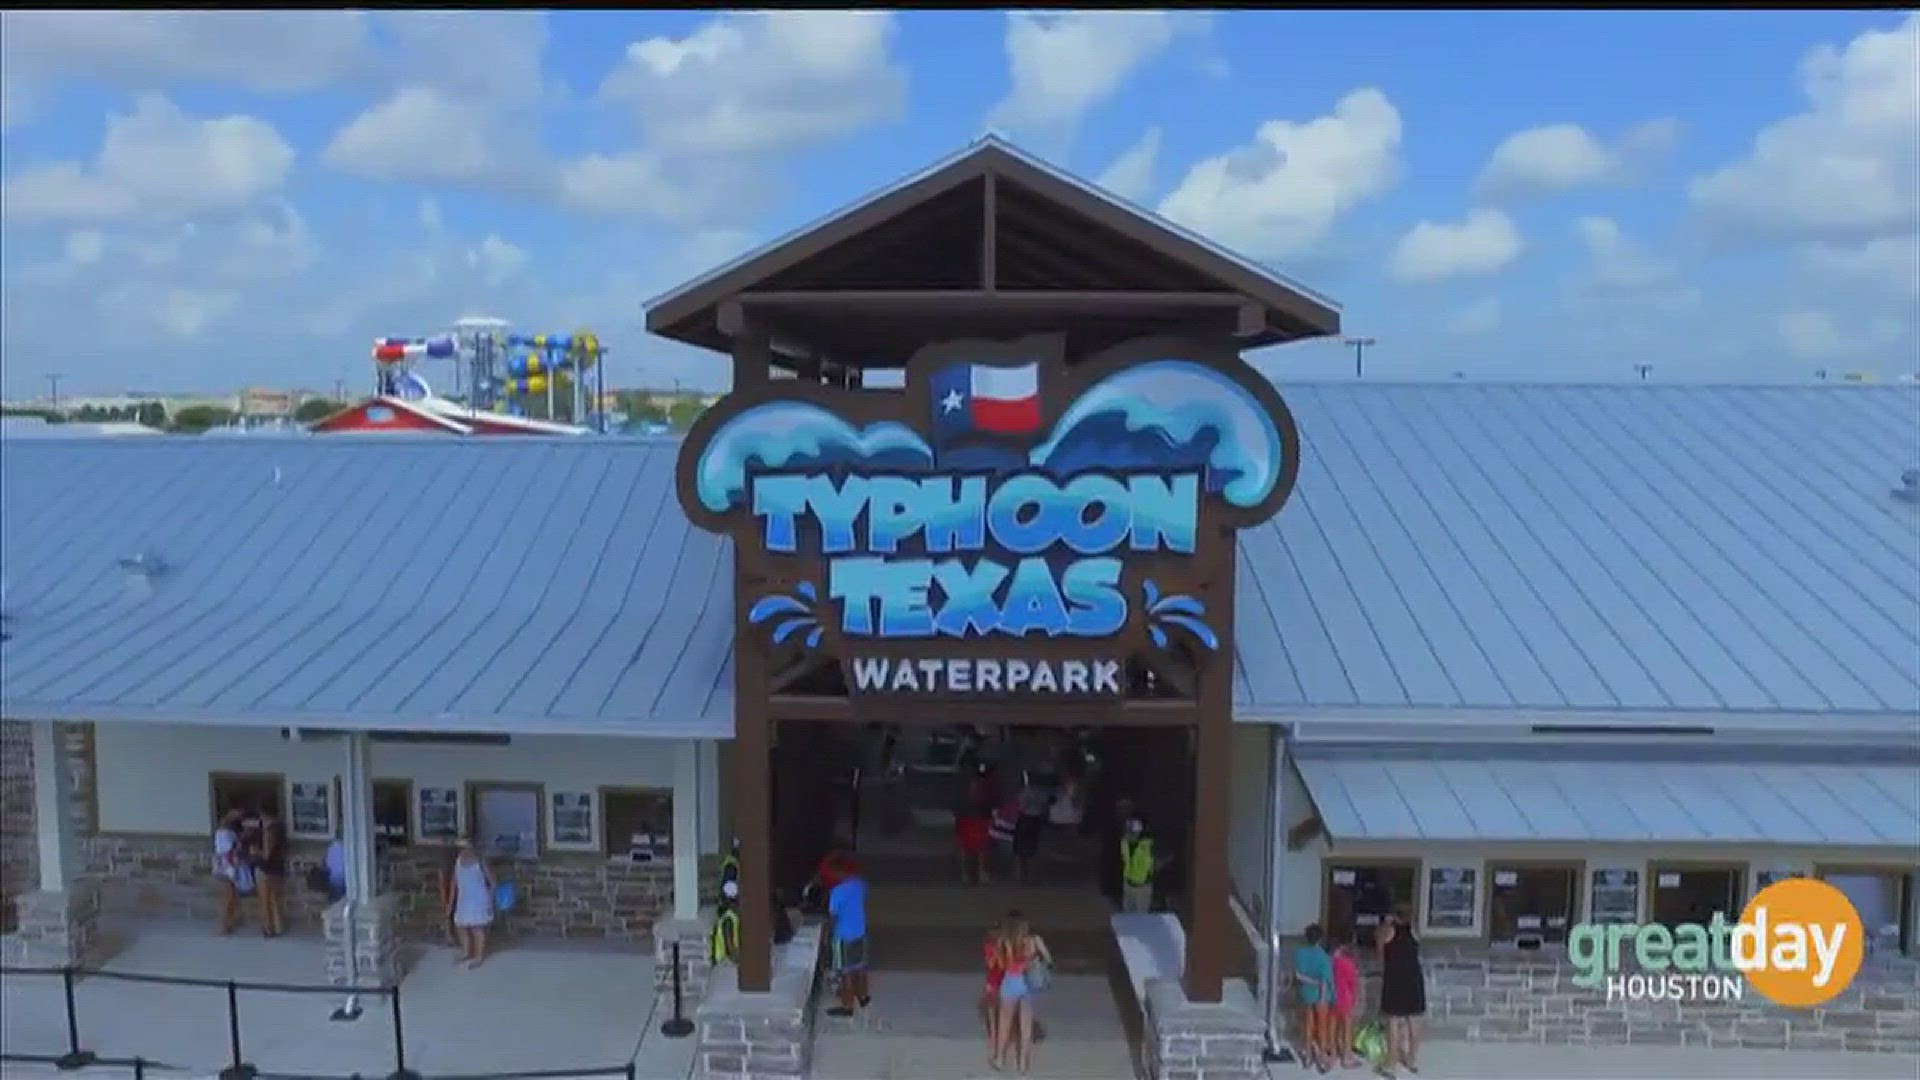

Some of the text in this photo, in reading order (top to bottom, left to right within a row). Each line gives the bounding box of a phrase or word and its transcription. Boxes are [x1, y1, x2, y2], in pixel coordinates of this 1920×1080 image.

[752, 473, 1199, 553] TYPHOON
[829, 557, 1128, 637] TEXAS
[853, 659, 1121, 694] WATERPARK
